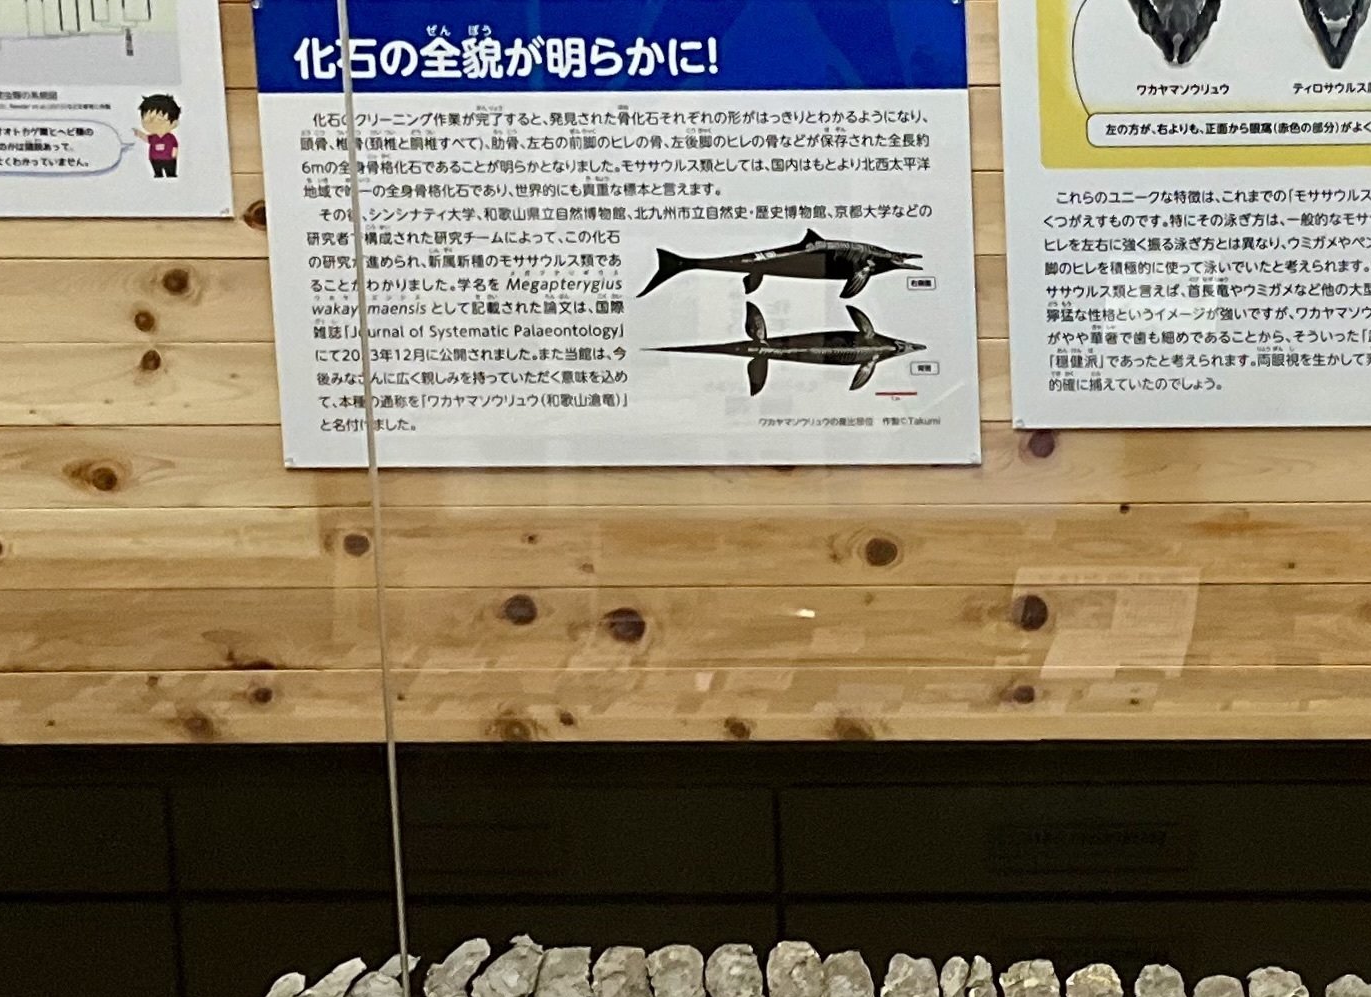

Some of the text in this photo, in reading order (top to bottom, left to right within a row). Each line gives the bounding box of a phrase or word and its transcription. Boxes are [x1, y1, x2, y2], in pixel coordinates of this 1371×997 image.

[426, 24, 451, 36] ぜん
[1137, 84, 1230, 96] ワカヤマソウリュウ
[307, 230, 621, 245] 研究者構成された研究チームによって、この化石
[506, 277, 623, 294] Megapterygius
[312, 303, 426, 317] wakaymaensis
[409, 325, 423, 338] of
[429, 325, 510, 340] Systematic
[315, 346, 626, 362] にて203年12月に公開されました。また当館は、今
